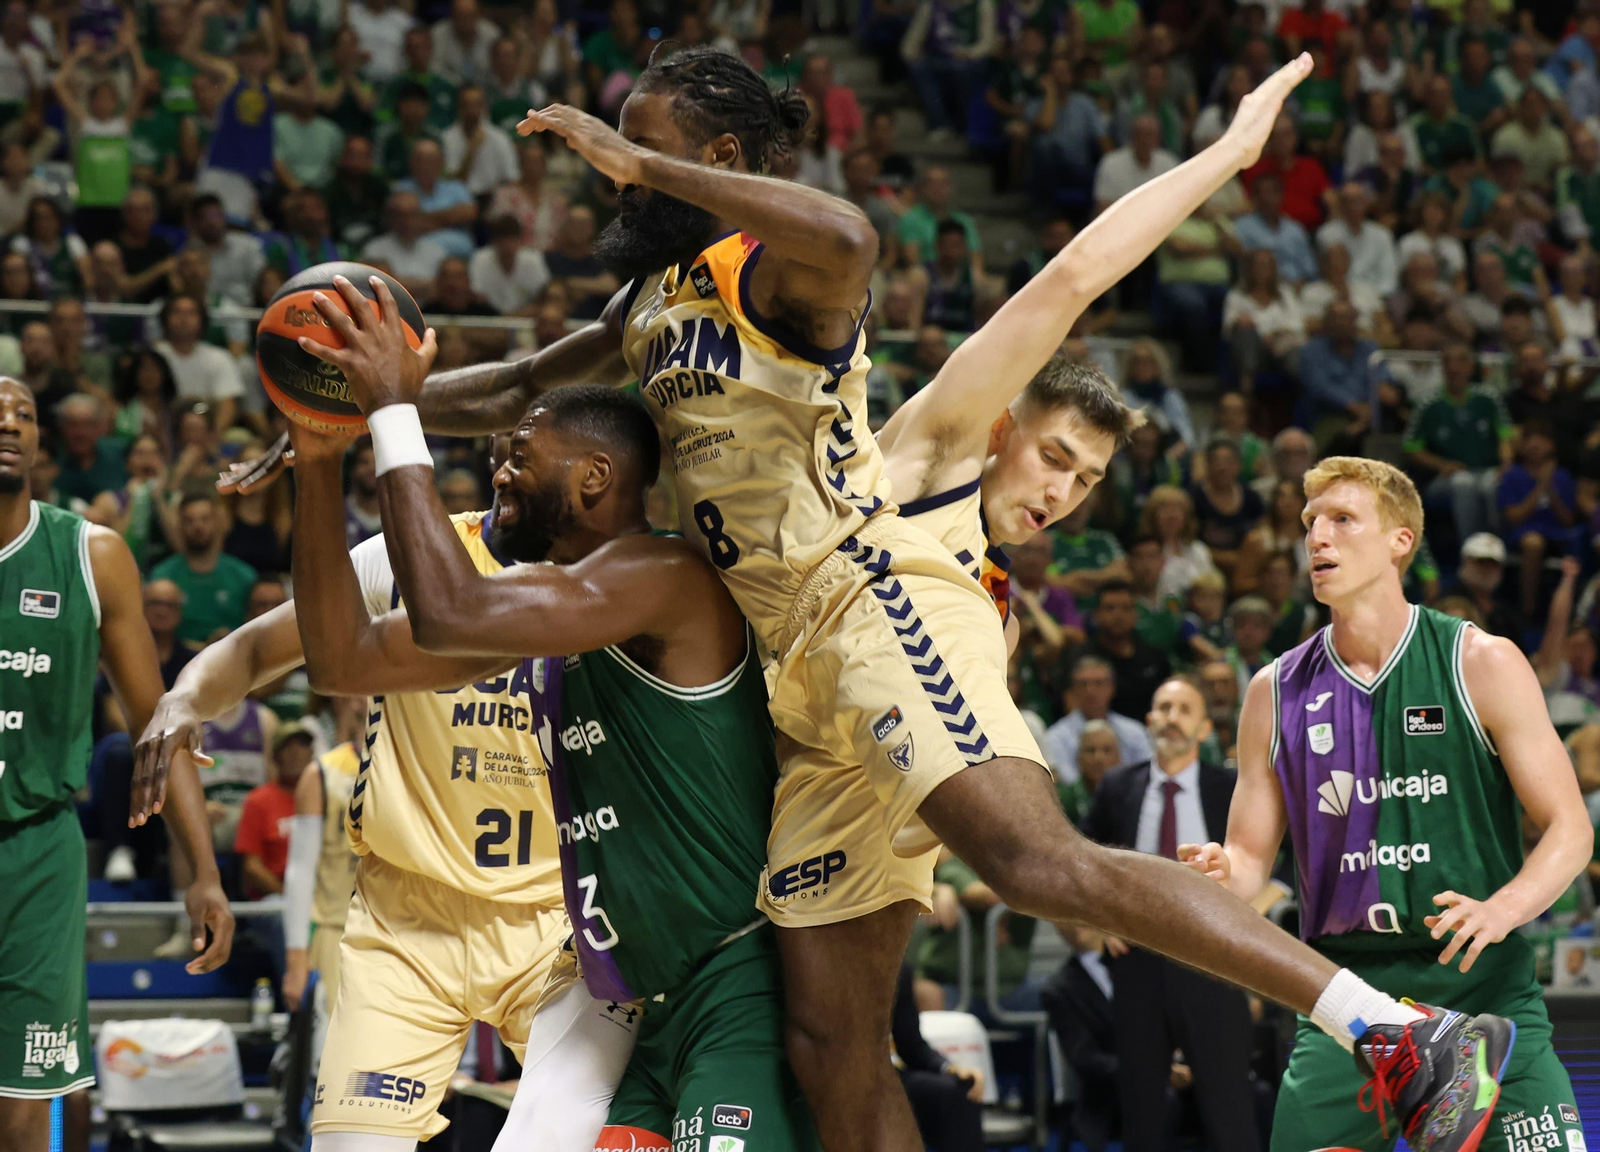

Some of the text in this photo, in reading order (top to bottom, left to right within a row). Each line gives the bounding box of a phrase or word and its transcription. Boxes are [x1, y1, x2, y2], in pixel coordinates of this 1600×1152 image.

[649, 370, 725, 409] URCIA
[692, 435, 713, 451] CRUZ
[713, 429, 735, 444] 2024
[691, 448, 722, 469] JUBILAR
[694, 499, 740, 570] 8
[451, 702, 536, 736] MURC
[877, 716, 897, 739] acb
[484, 751, 529, 764] CARAVAC
[484, 762, 496, 771] DE
[497, 764, 509, 773] LA
[510, 765, 531, 776] CRU
[483, 773, 503, 784] AÑO
[1356, 769, 1448, 804] Unicaja
[475, 808, 533, 868] 21
[769, 850, 847, 897] ESP
[577, 874, 620, 951] 3
[24, 1041, 66, 1070] laga
[362, 1072, 426, 1105] ESP
[339, 1099, 412, 1115] SOLUTIONS
[716, 1113, 742, 1126] acb
[1511, 1105, 1559, 1140] má
